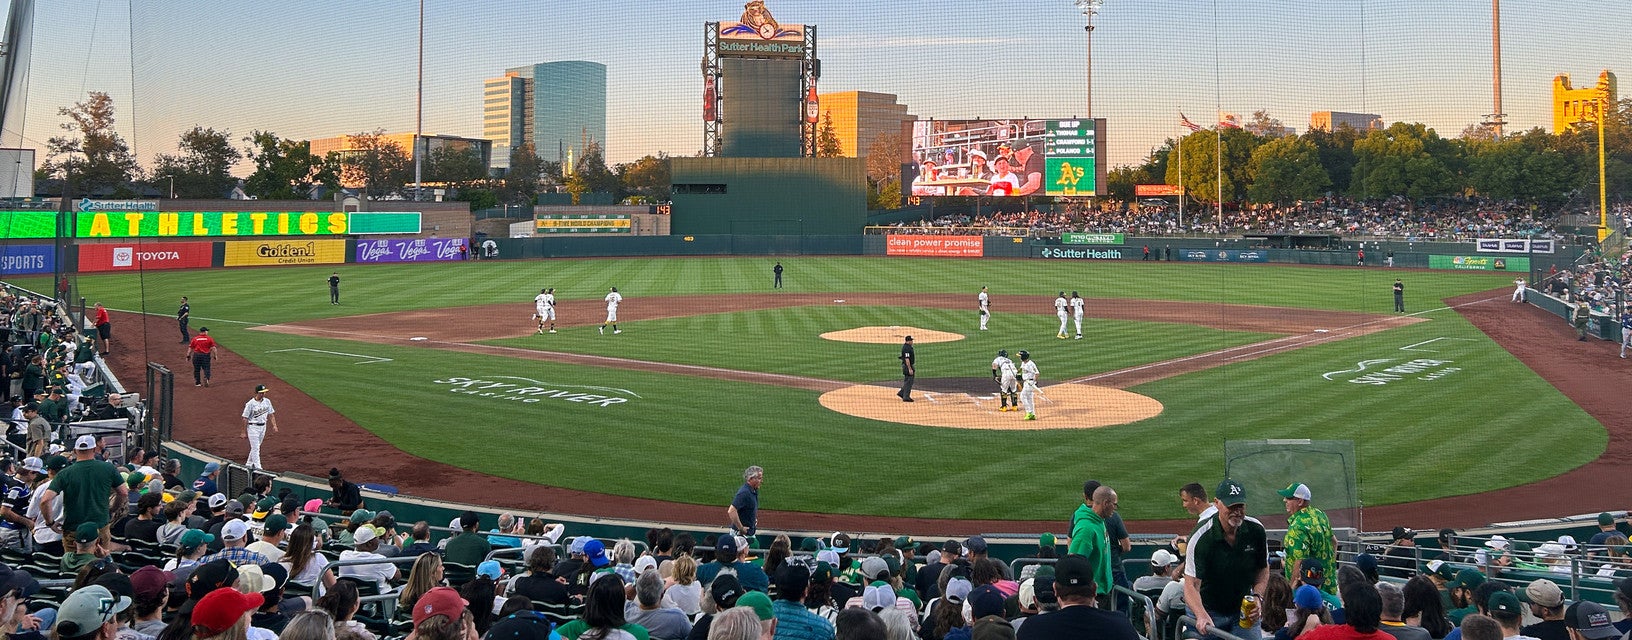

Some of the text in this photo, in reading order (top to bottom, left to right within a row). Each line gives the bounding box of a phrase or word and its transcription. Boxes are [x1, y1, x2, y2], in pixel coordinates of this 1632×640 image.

[720, 42, 804, 53] Sutter Health Park
[94, 202, 156, 210] Sutter Health
[907, 197, 920, 206] 143
[657, 206, 670, 214] 143
[90, 213, 347, 236] ATHLETICS
[890, 237, 980, 248] clean power promise
[358, 240, 393, 260] Vegas
[396, 240, 430, 260] Vegas
[433, 240, 460, 258] Vega
[1053, 248, 1121, 259] Sutter Health
[136, 251, 179, 261] TOYOTA
[1464, 256, 1488, 265] Sports
[1, 255, 44, 269] SPORTS
[433, 377, 628, 407] SKY RIVER
